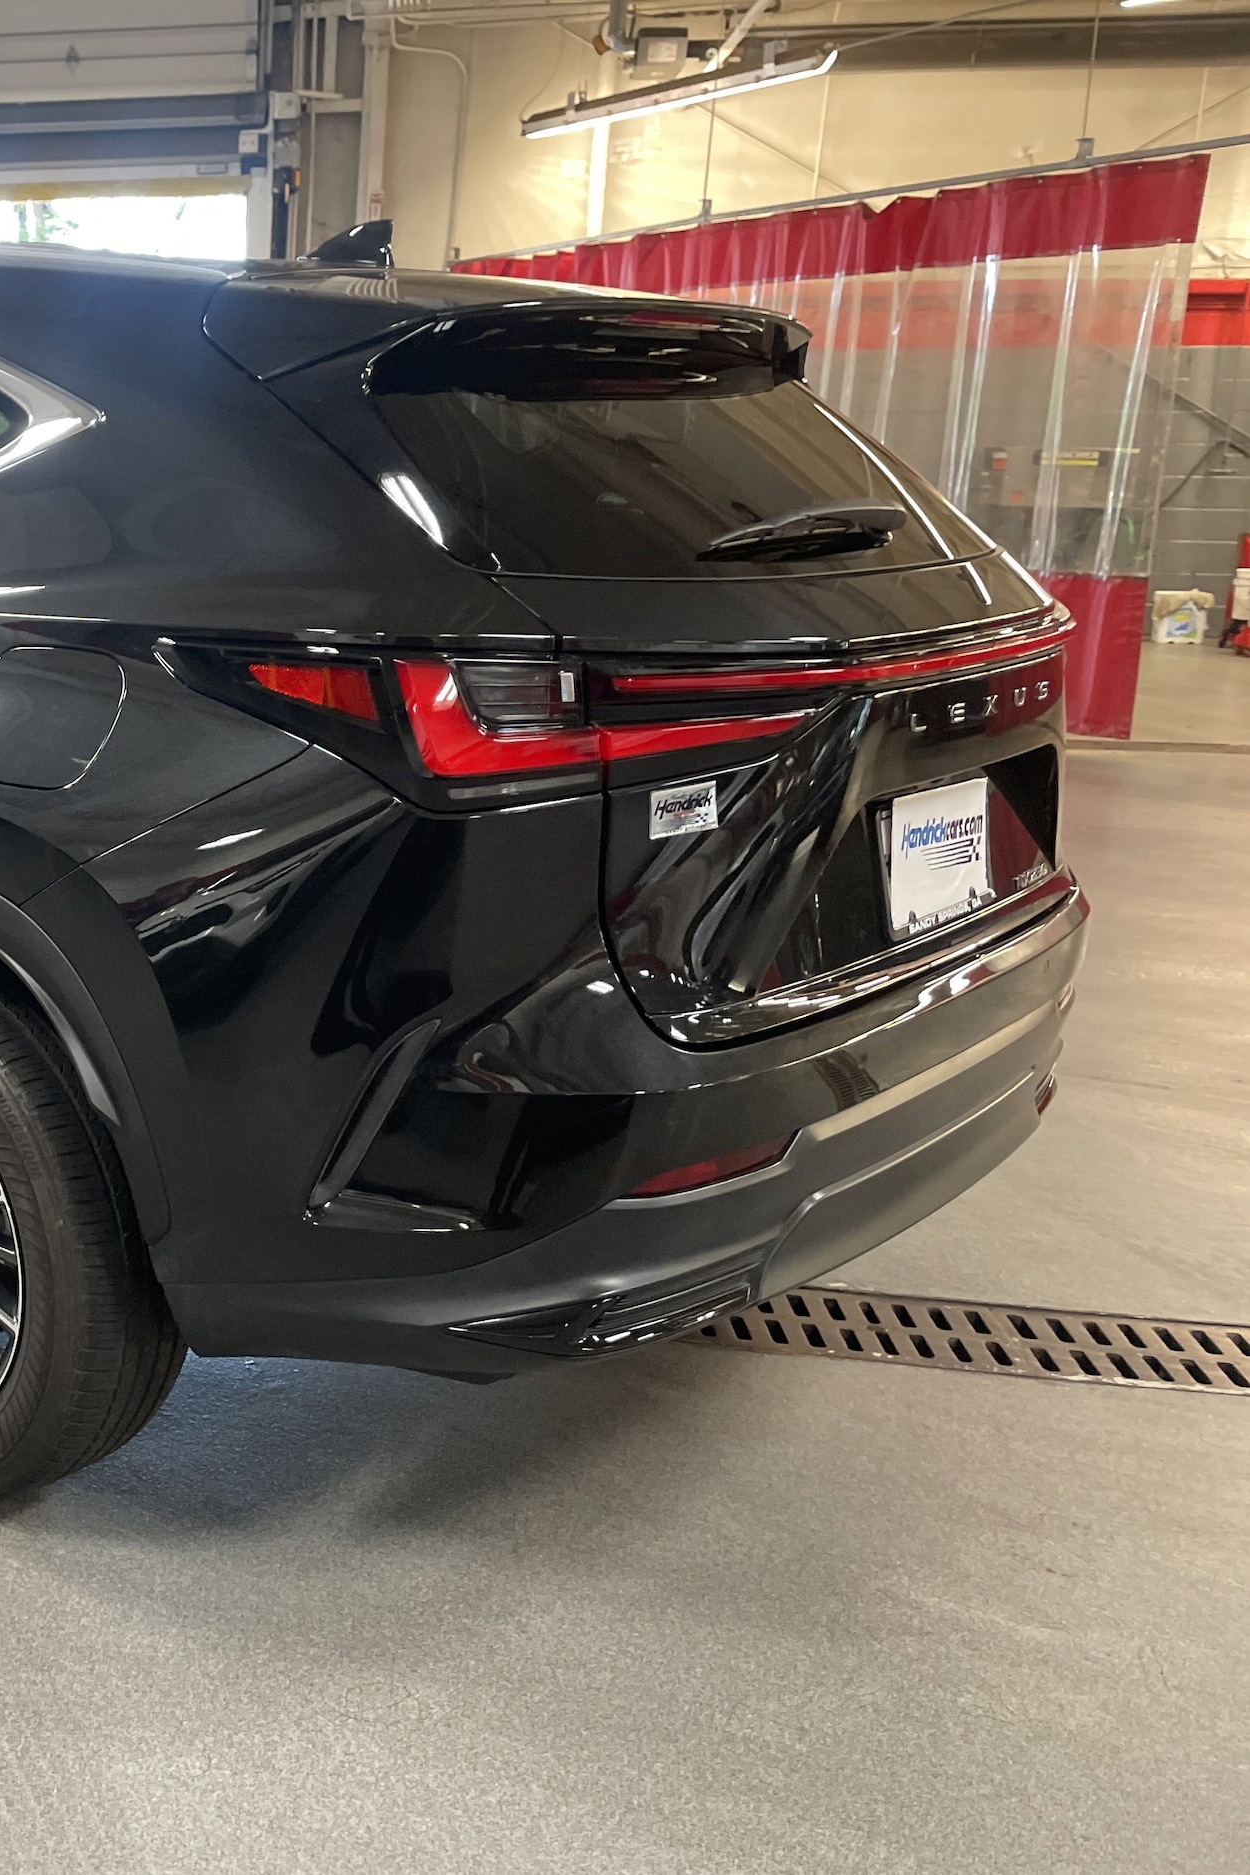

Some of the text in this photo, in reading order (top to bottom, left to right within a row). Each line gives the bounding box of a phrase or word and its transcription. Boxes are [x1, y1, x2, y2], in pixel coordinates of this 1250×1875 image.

[910, 681, 1050, 733] LEXUS
[654, 789, 713, 820] Hendrick
[900, 814, 984, 860] Hendrickcars.com
[909, 914, 937, 935] SANDY
[971, 896, 983, 909] GA
